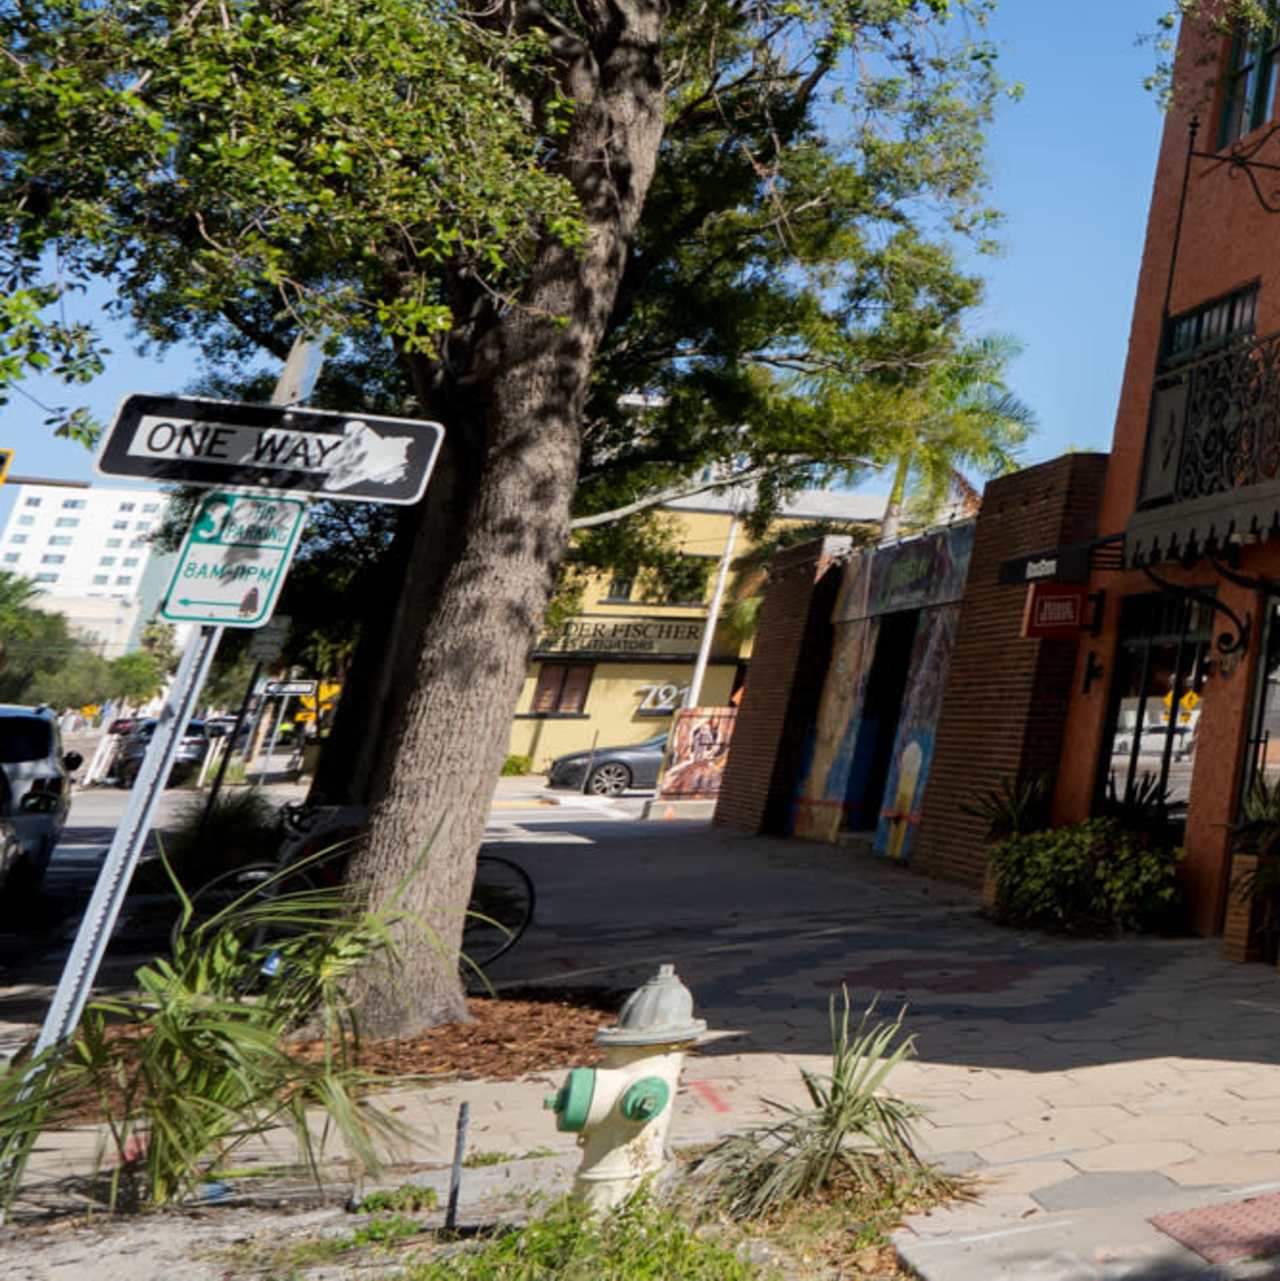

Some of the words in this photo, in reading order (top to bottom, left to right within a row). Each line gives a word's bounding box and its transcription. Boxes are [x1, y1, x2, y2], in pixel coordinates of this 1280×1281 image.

[146, 422, 236, 459] ONE
[253, 429, 343, 467] WAY
[611, 623, 700, 640] FISCHER
